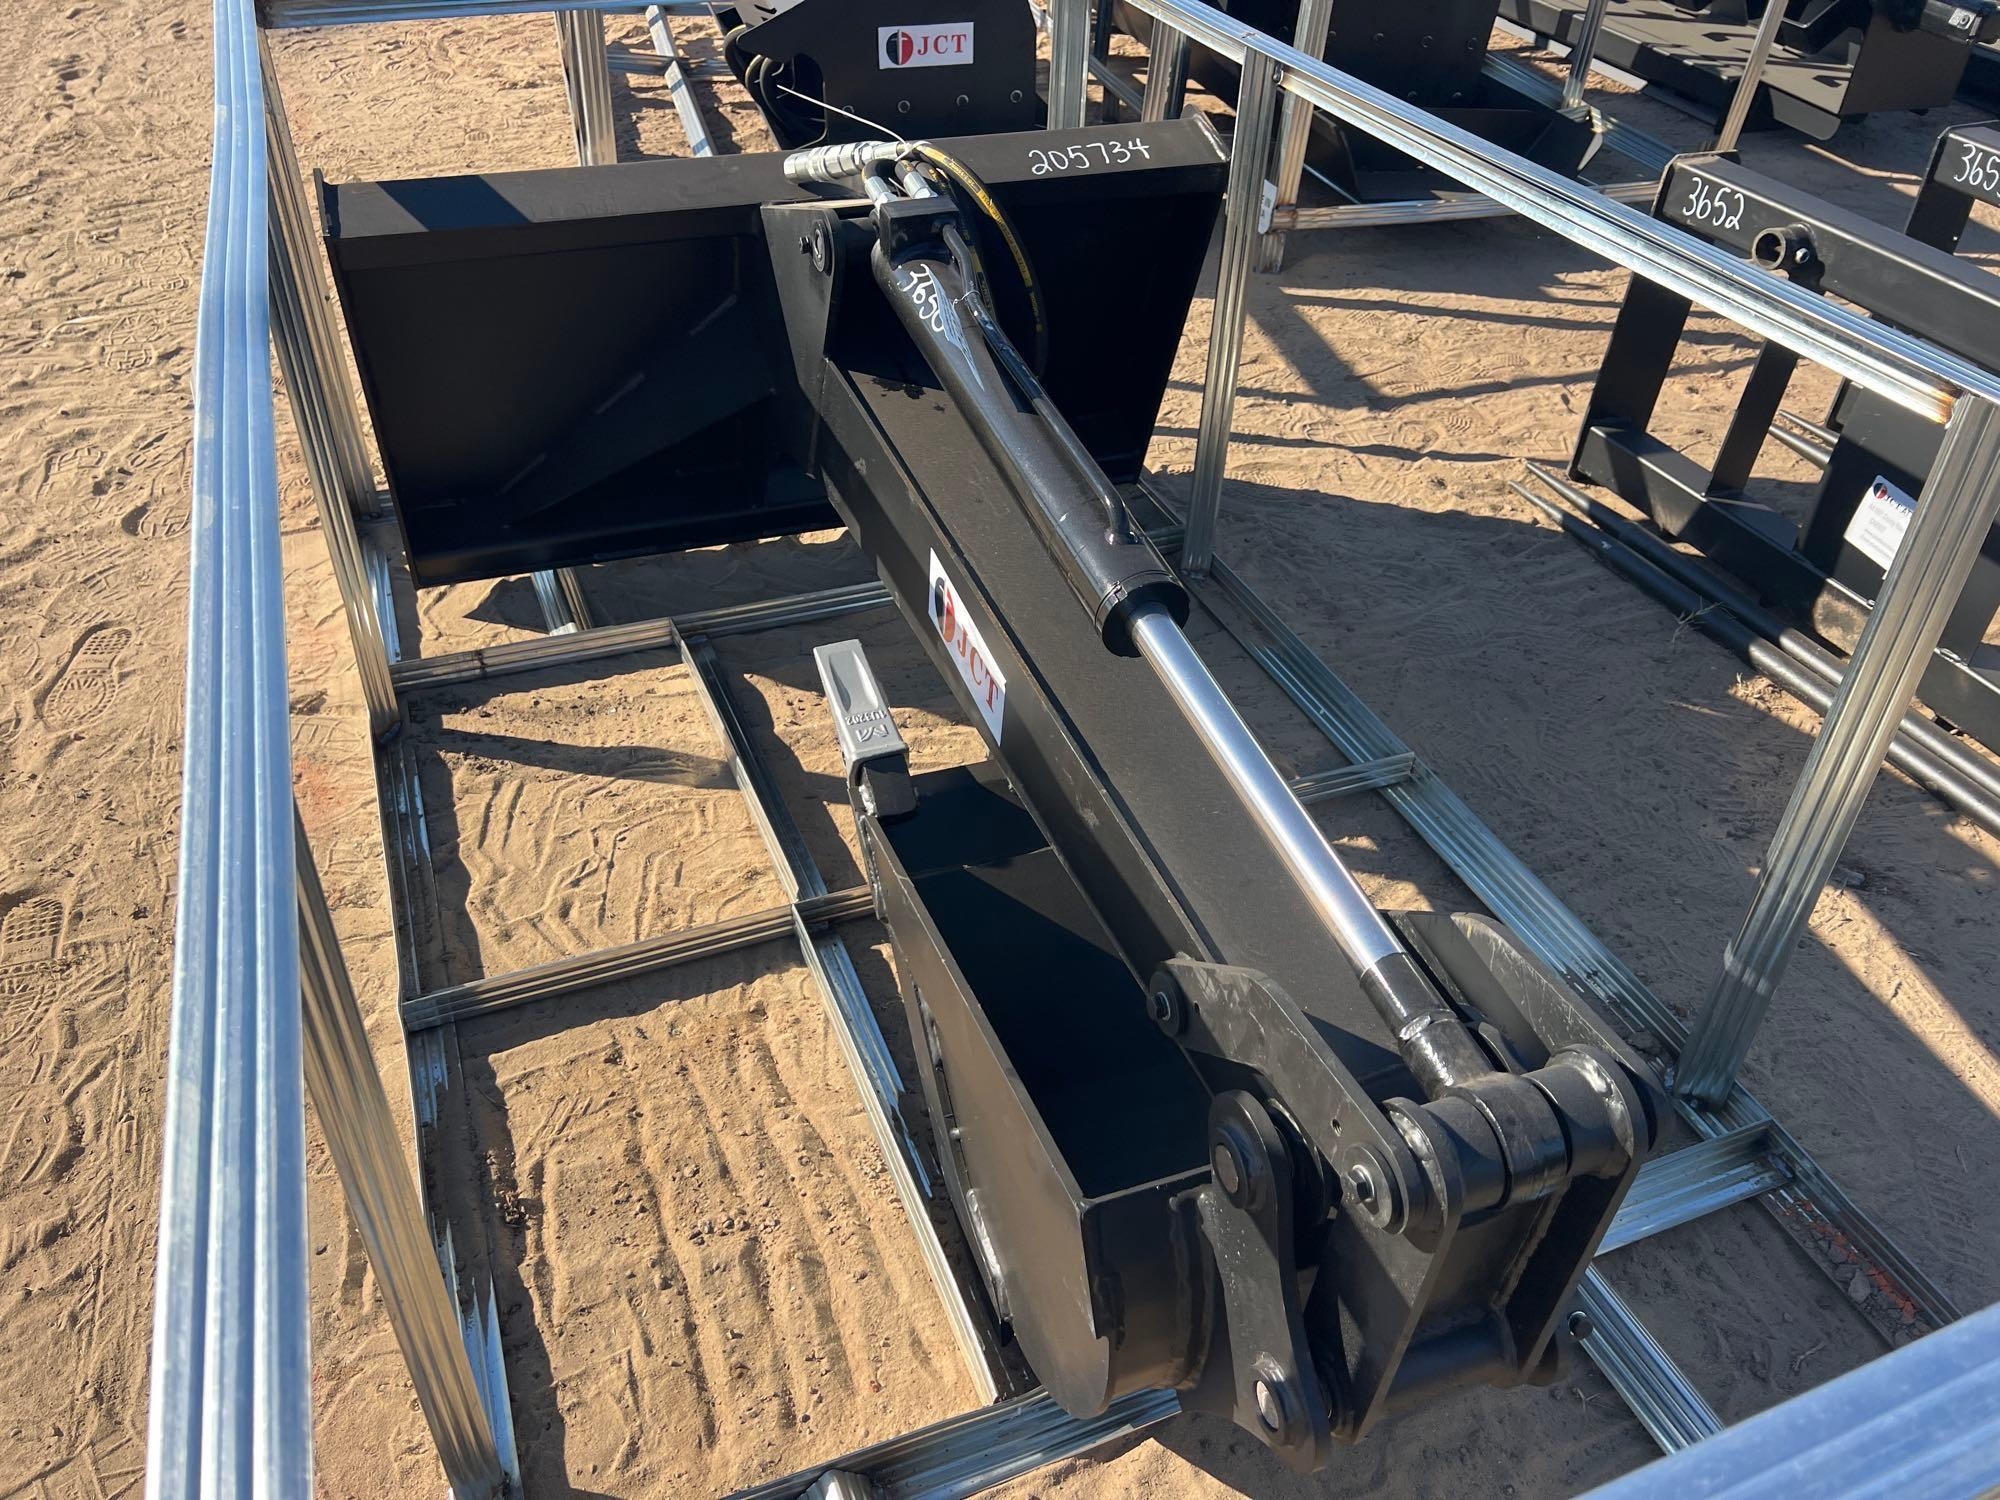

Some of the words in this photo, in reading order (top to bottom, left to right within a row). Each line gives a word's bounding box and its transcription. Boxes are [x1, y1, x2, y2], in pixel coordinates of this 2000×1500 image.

[917, 33, 967, 56] JCT
[1028, 137, 1150, 175] 205734
[1953, 143, 2000, 198] 365
[1682, 176, 1744, 230] 3652
[957, 623, 998, 713] JCT
